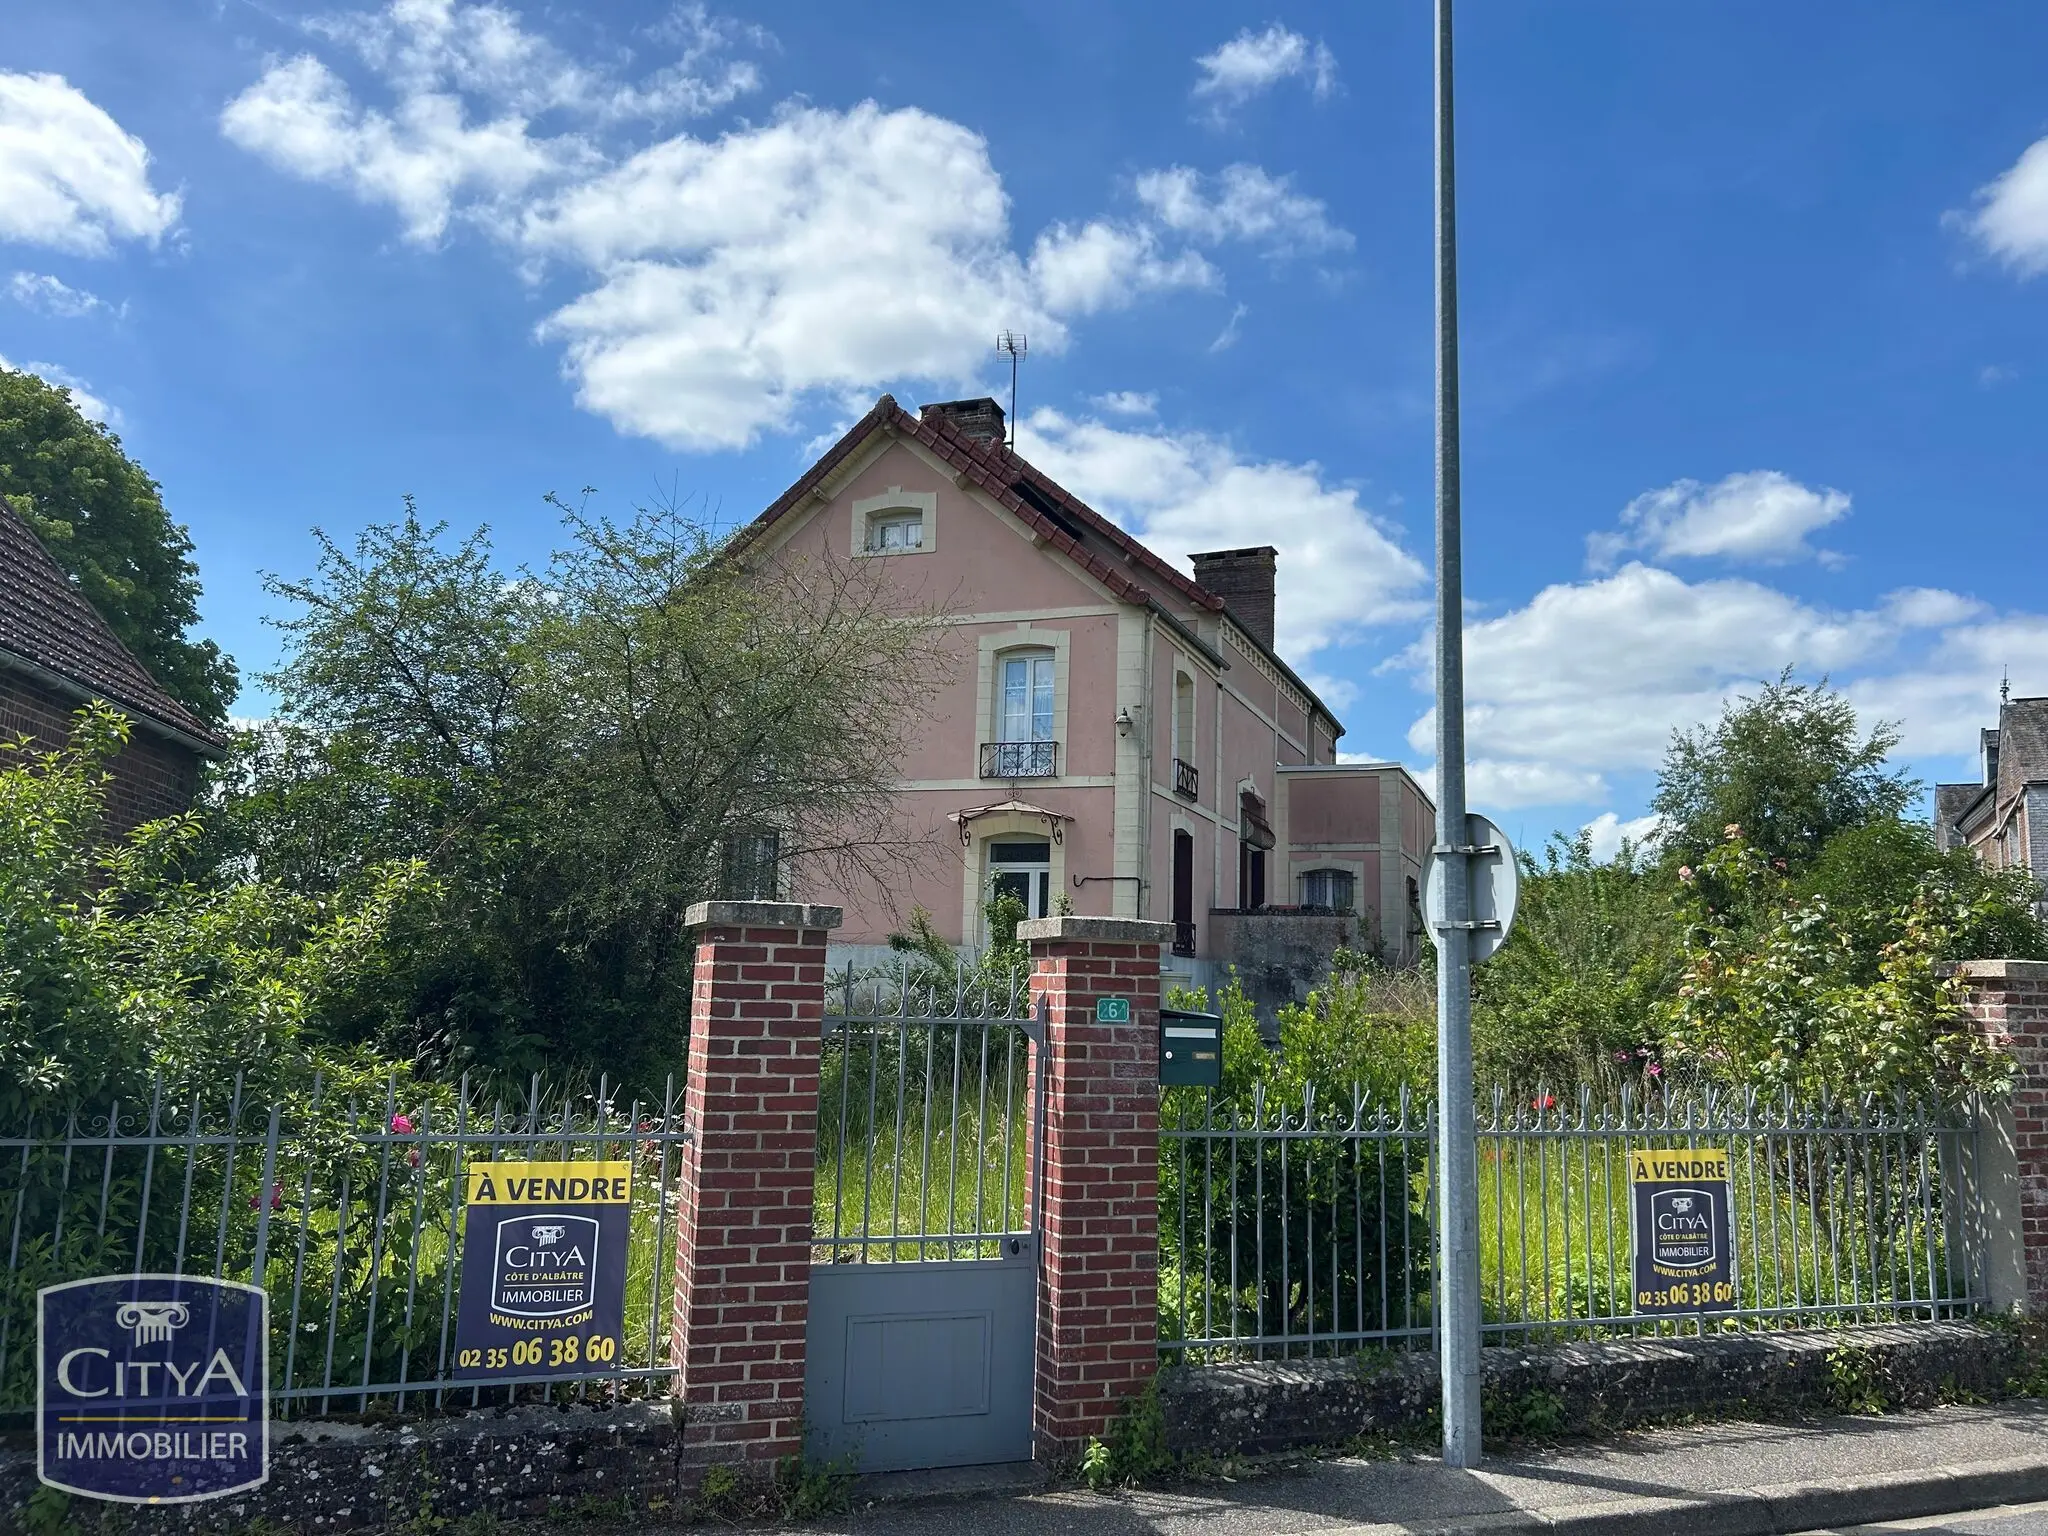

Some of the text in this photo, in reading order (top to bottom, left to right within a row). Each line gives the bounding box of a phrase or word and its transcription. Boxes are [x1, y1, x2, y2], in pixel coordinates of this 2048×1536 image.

[1635, 1157, 1727, 1179] À VENDRE
[475, 1172, 627, 1201] À VENDRE
[1659, 1232, 1708, 1241] CÔTE D'ALBÂTRE
[1659, 1246, 1709, 1257] IMMOBILIER
[505, 1271, 584, 1281] CÔTE D'ALBÂTRE
[1652, 1262, 1717, 1278] WWW.CITYA.COM
[502, 1289, 584, 1304] IMMOBILIER
[1638, 1281, 1732, 1306] 02 35 06 38 60
[489, 1309, 593, 1331] WWW.CITYA.COM
[459, 1334, 615, 1369] 02 35 06 38 60
